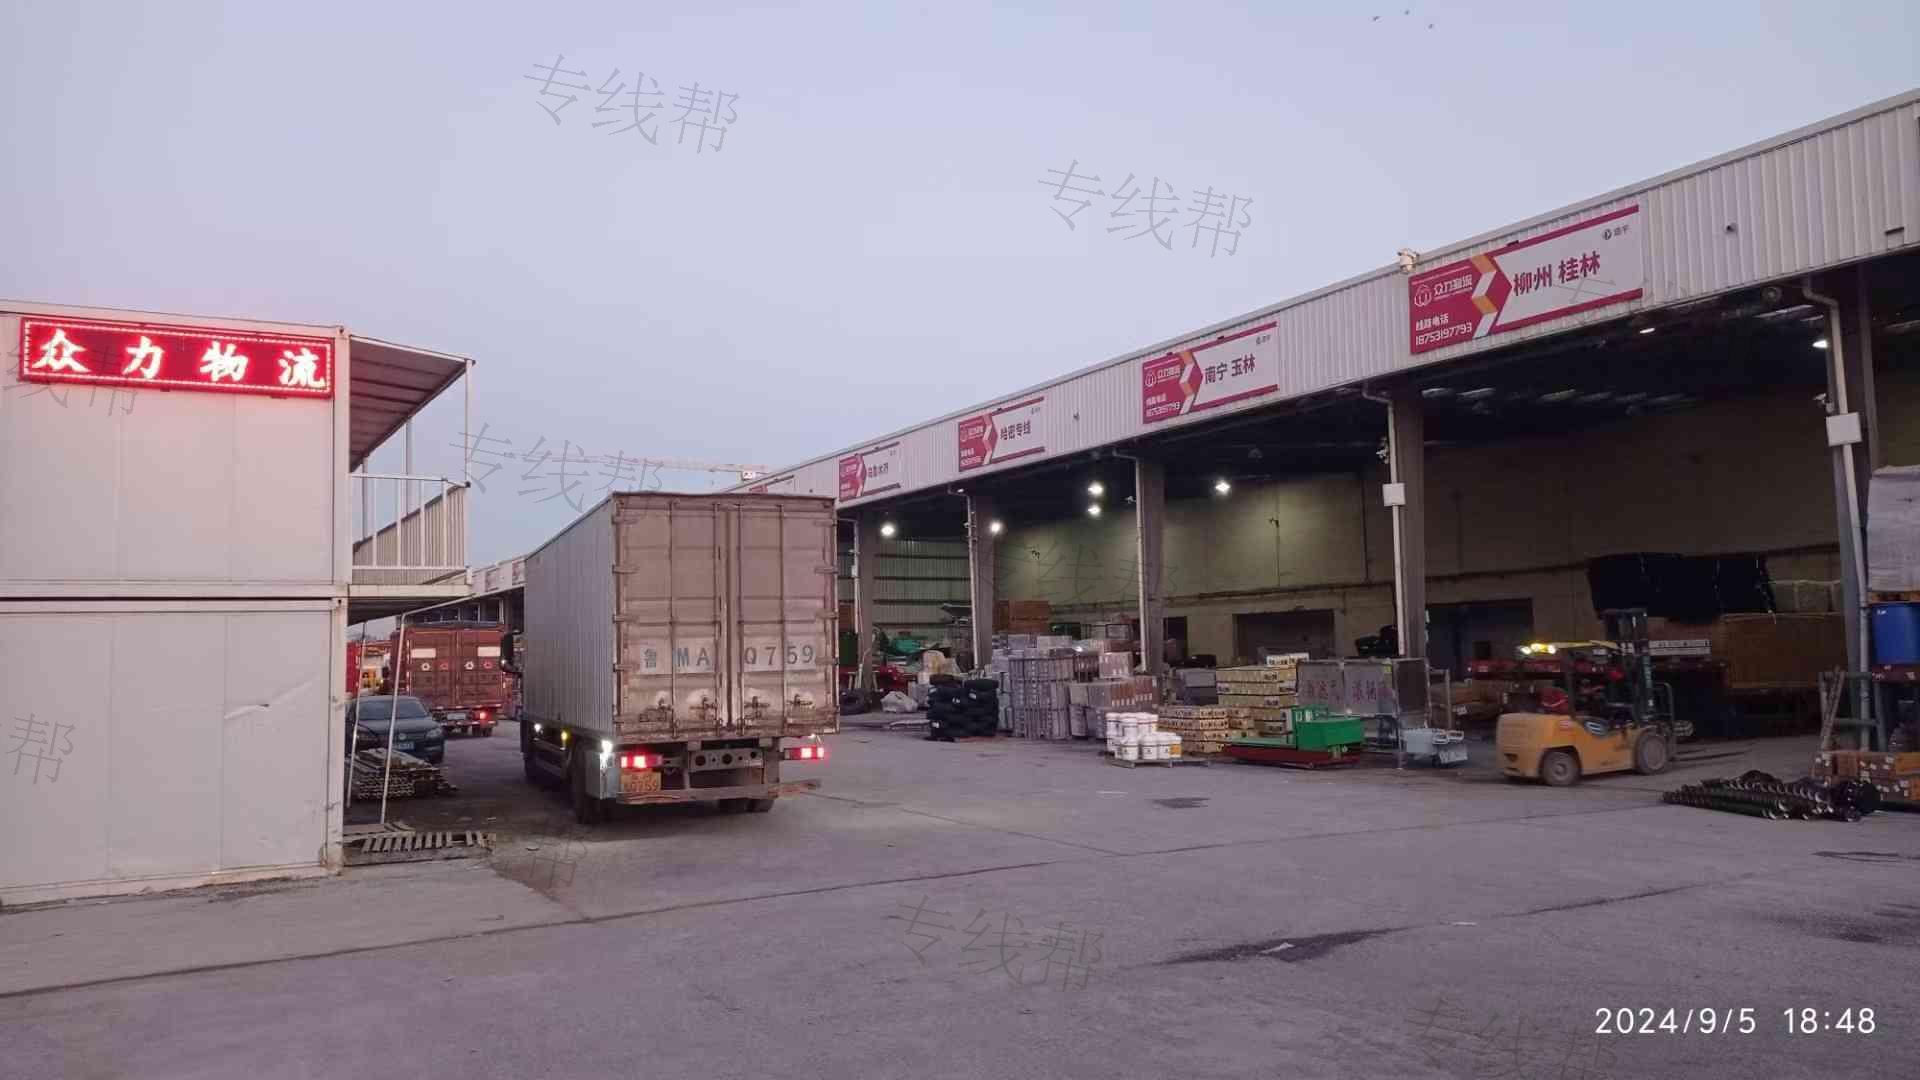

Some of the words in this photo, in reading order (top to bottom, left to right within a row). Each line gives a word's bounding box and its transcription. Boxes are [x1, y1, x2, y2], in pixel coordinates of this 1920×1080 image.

[1513, 263, 1553, 297] 柳州
[1558, 249, 1601, 285] 桂林
[31, 328, 326, 390] 众力物流
[1204, 362, 1229, 385] 南宁
[1231, 353, 1256, 378] 玉林
